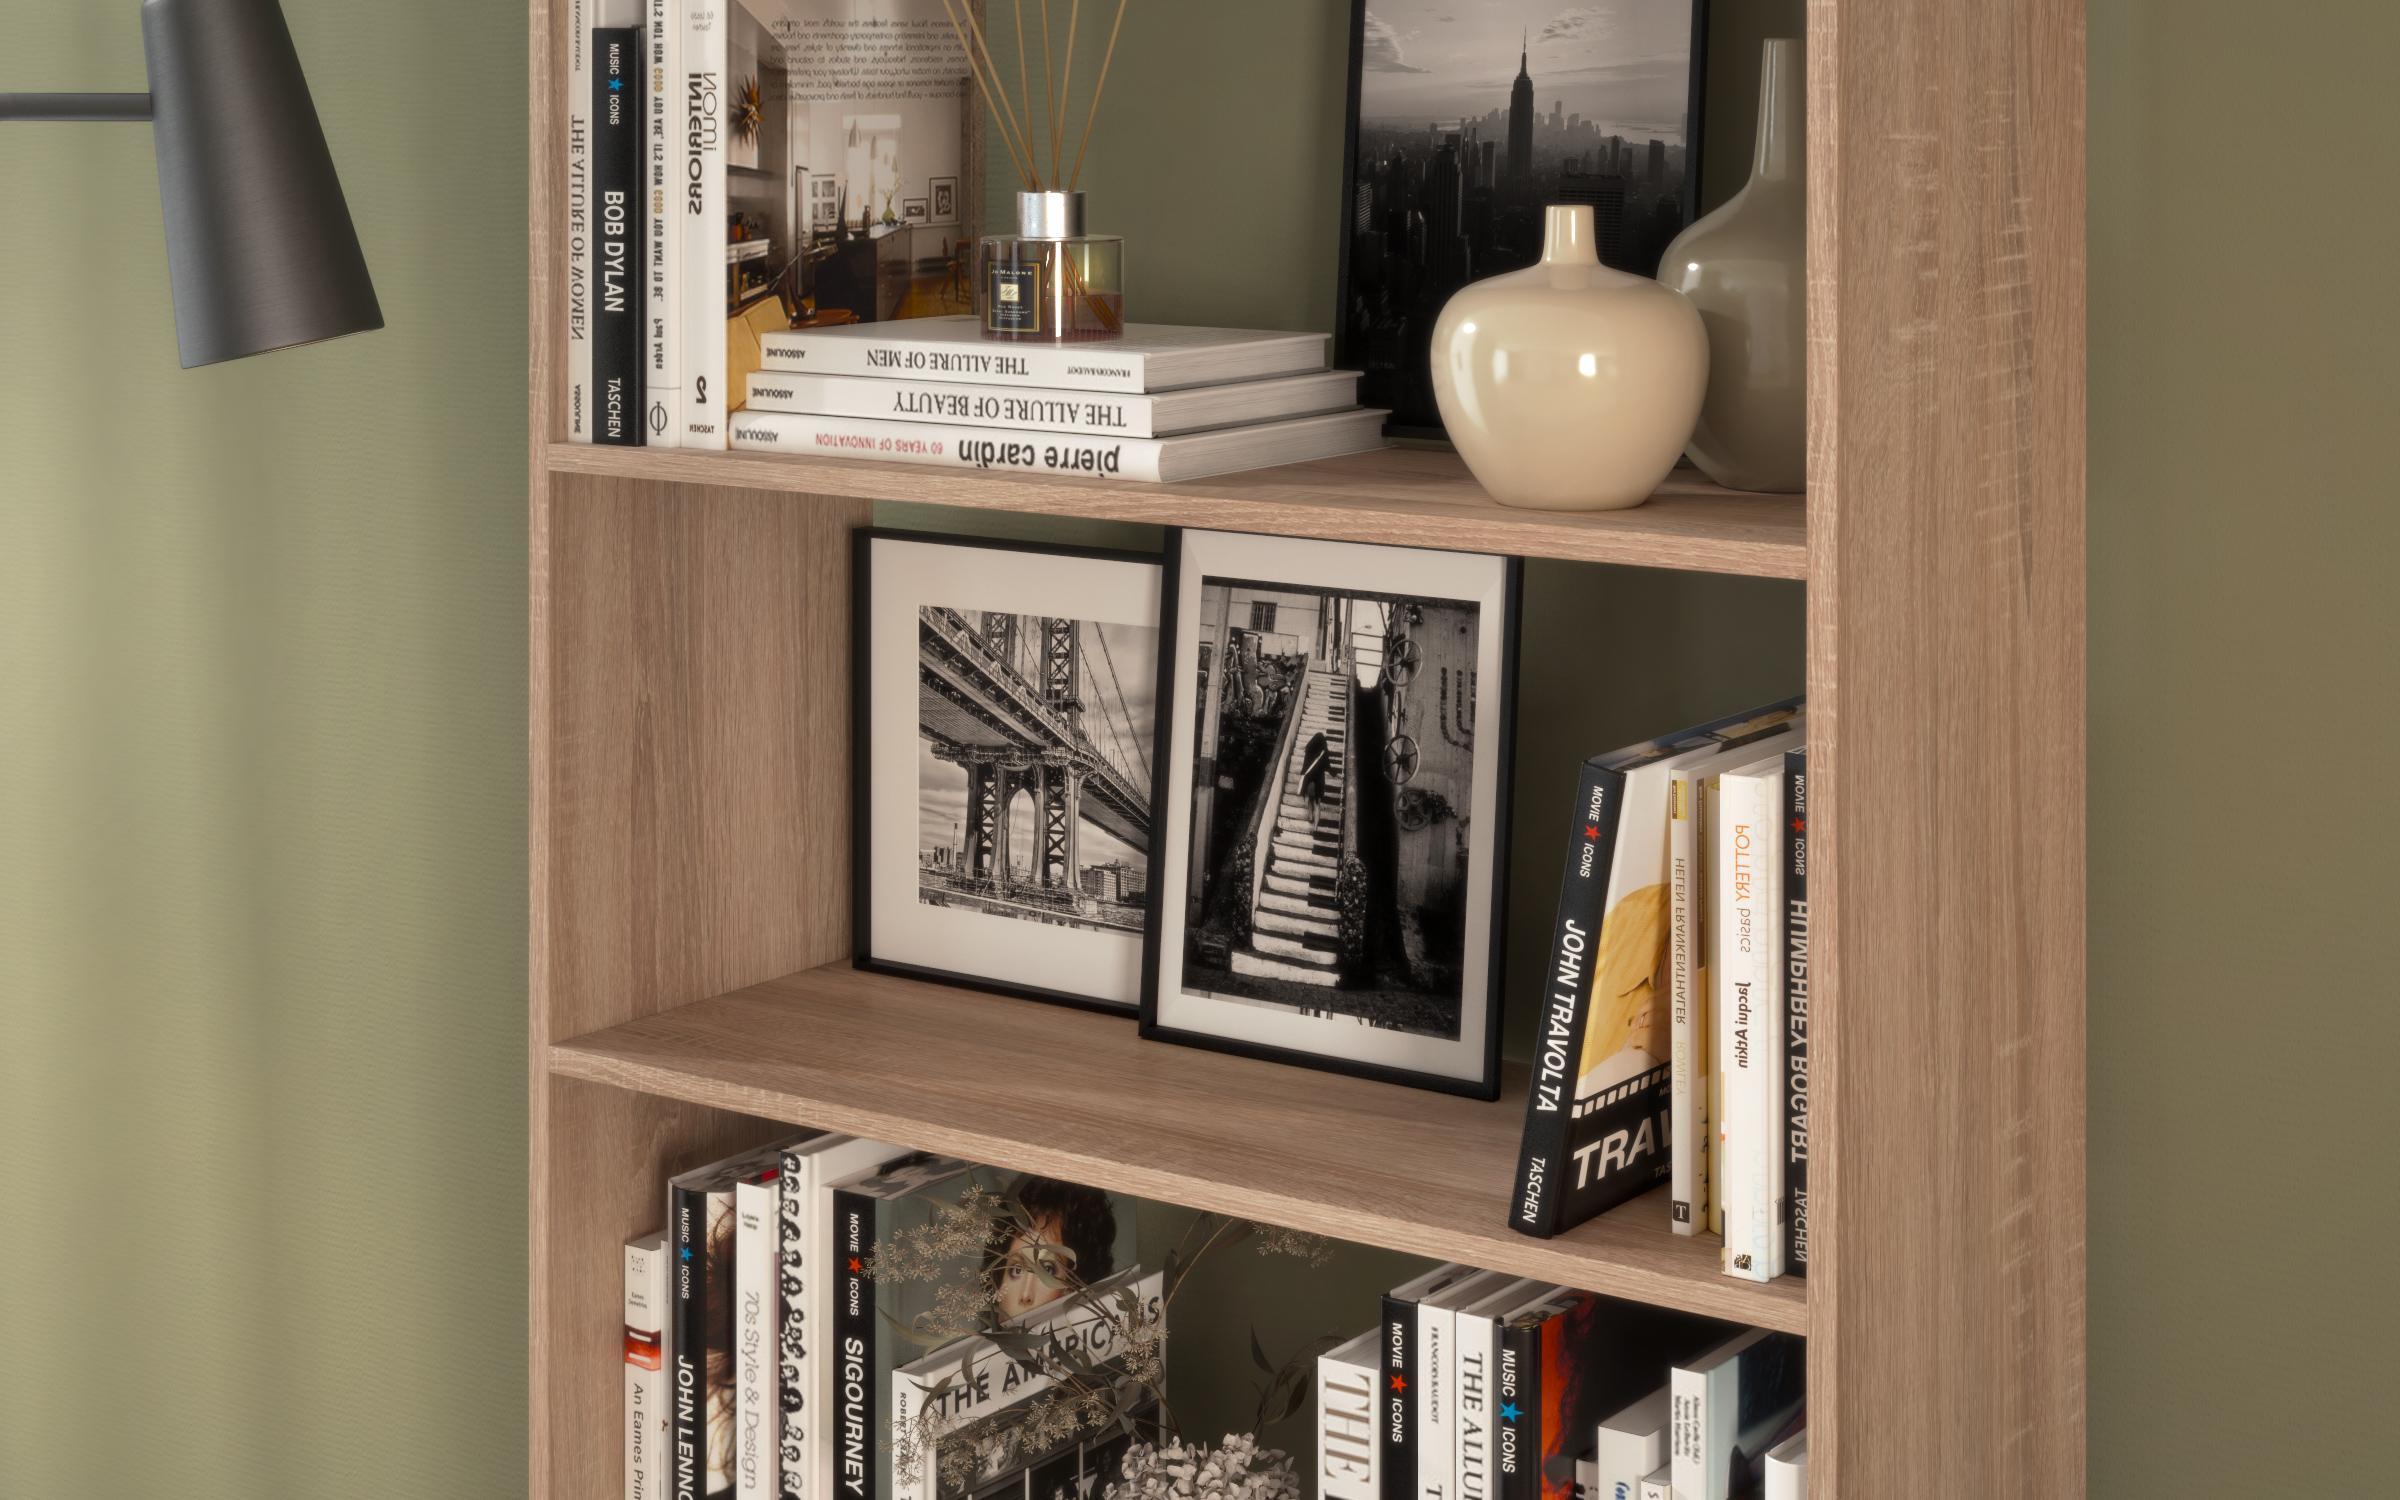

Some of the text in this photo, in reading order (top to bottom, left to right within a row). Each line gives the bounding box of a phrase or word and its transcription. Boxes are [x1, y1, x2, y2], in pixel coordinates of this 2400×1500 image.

[610, 43, 620, 126] MUSIC ICONS
[604, 191, 624, 312] BOB DYLAN
[867, 348, 1030, 376] THE ALLURE OF MEN
[608, 377, 621, 438] TASCHEN
[816, 432, 944, 454] 60 YEARS OF INNOVATION
[893, 391, 1126, 427] THE ALLURE OF BEAUTY
[958, 440, 1120, 478] pierre cardin
[1580, 785, 1604, 878] MOVIE ICONS
[1536, 918, 1586, 1112] JOHN TRAVOLTA
[1522, 1156, 1546, 1224] TASCHEN
[682, 1207, 690, 1300] MUSIC ICONS
[850, 1212, 859, 1316] MOVIE ICONS
[634, 1382, 644, 1405] An
[678, 1354, 694, 1422] JOHN
[742, 1290, 760, 1490] 70s Style & Design
[844, 1337, 864, 1497] SIGOURNEY
[936, 1372, 990, 1418] THE
[1392, 1322, 1402, 1444] MOVIE ICONS
[1464, 1352, 1483, 1500] THE ALLU
[1502, 1349, 1516, 1474] MUSIC ICONS
[634, 1410, 644, 1464] Eames
[1324, 1373, 1370, 1484] THE
